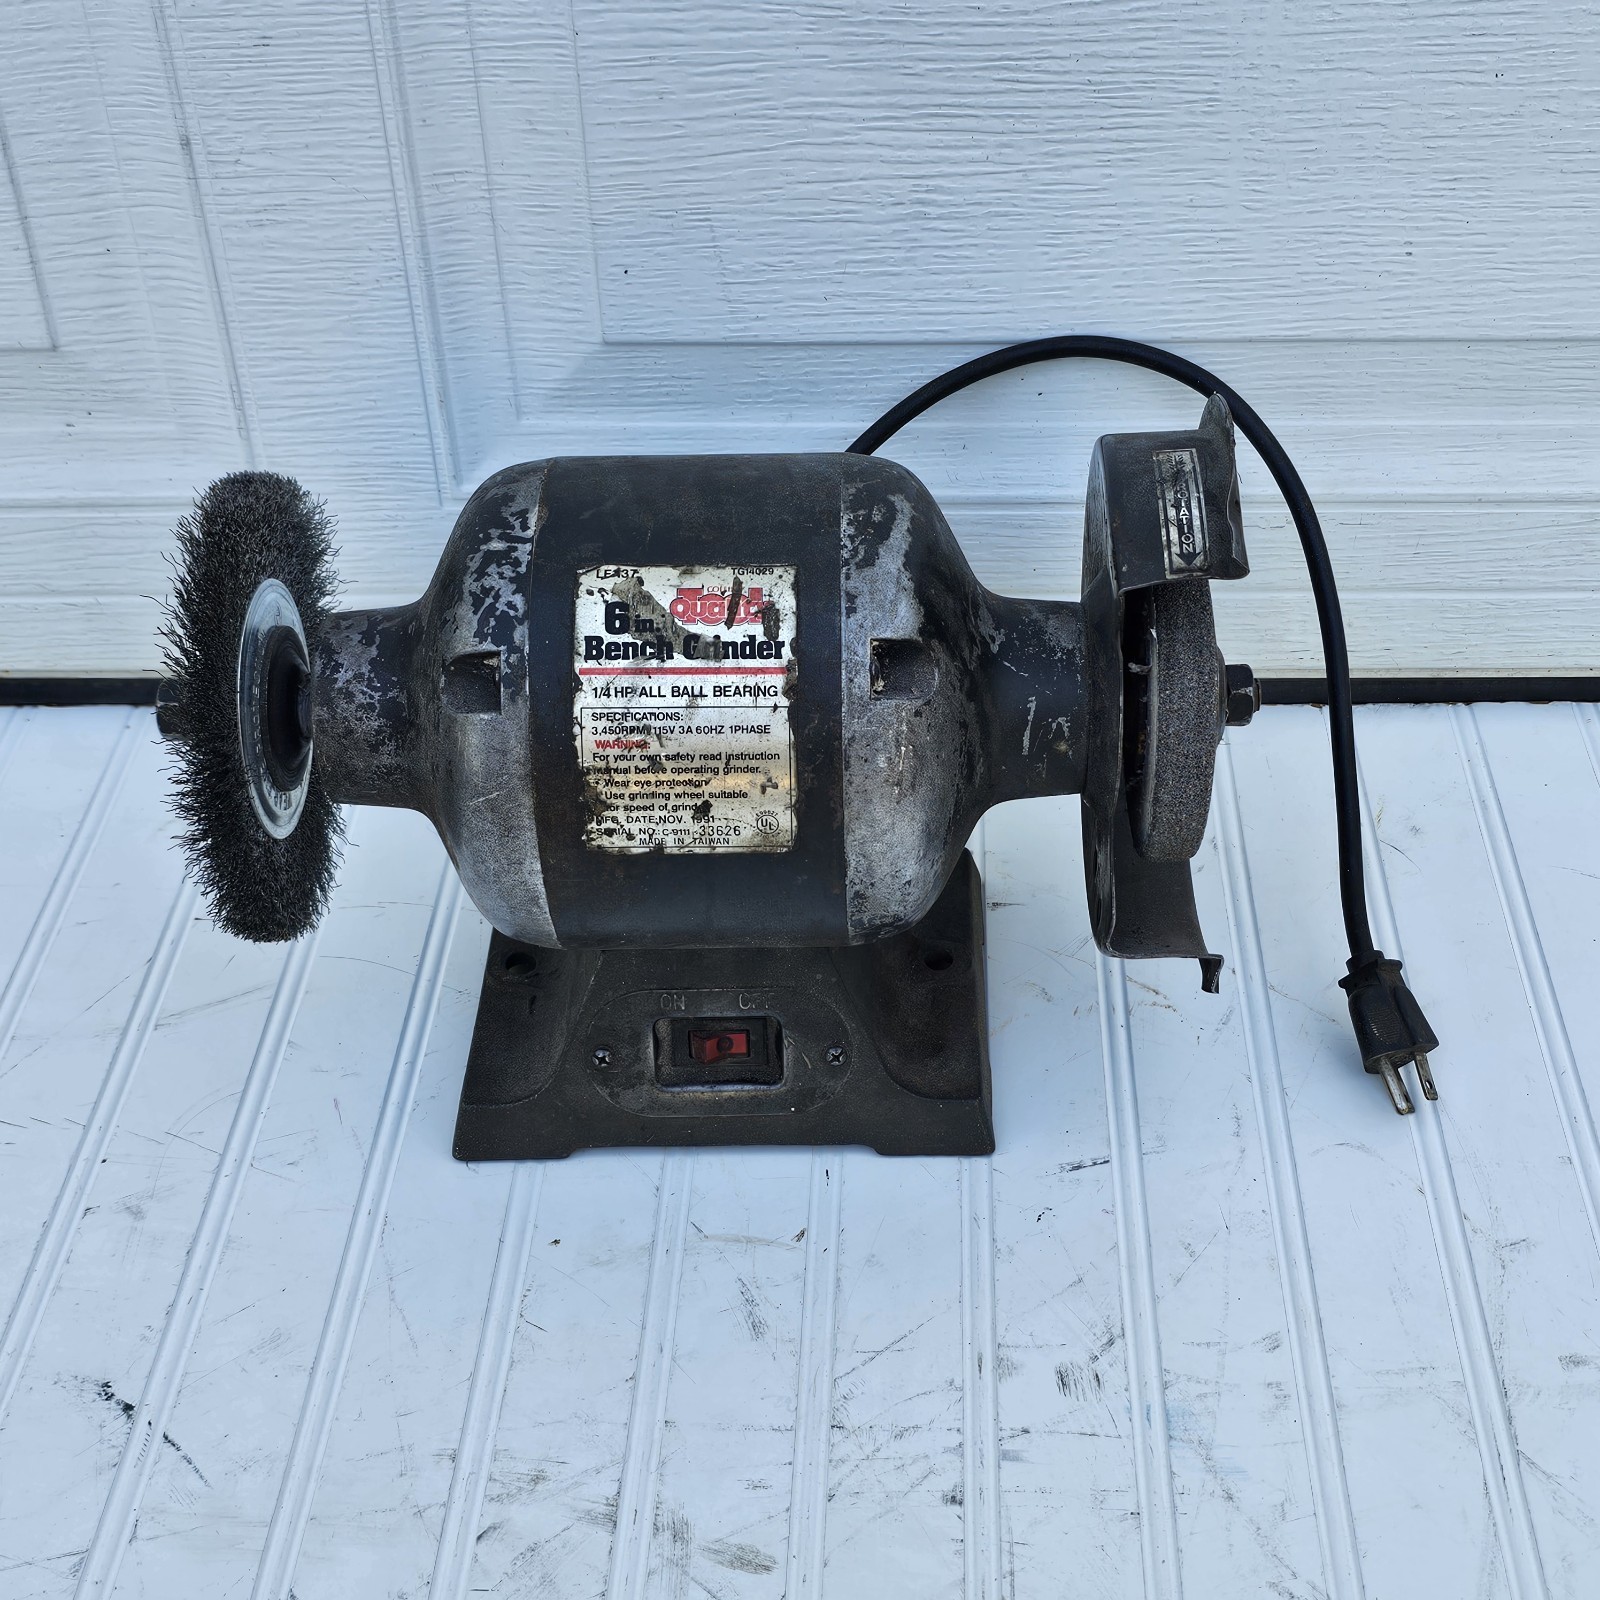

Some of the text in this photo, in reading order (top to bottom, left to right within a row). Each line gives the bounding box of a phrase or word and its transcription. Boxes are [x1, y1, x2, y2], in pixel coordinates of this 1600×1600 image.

[604, 601, 630, 635] 6
[584, 634, 785, 661] Bench Gnder
[592, 686, 611, 698] 1/4
[639, 686, 666, 698] ALL
[671, 686, 708, 698] BALL
[713, 685, 778, 698] BEARING
[591, 712, 684, 722] SPECIFICATIONS:
[678, 725, 693, 735] 3A
[696, 726, 725, 735] 60HZ
[729, 725, 771, 735] 1PHASE
[593, 751, 780, 764] For your own safety read instruction
[634, 765, 668, 775] befoe
[671, 765, 719, 776] operating
[723, 765, 761, 775] grinder.
[604, 779, 630, 788] Wear
[633, 780, 652, 789] eye
[604, 791, 625, 800] Use
[674, 790, 704, 799] wheel
[708, 790, 748, 799] suitable
[606, 804, 620, 812] or
[623, 803, 655, 813] speed
[671, 802, 704, 813] grind
[595, 828, 634, 836] SRIAL
[699, 825, 741, 837] 33626
[660, 993, 686, 1010] ON
